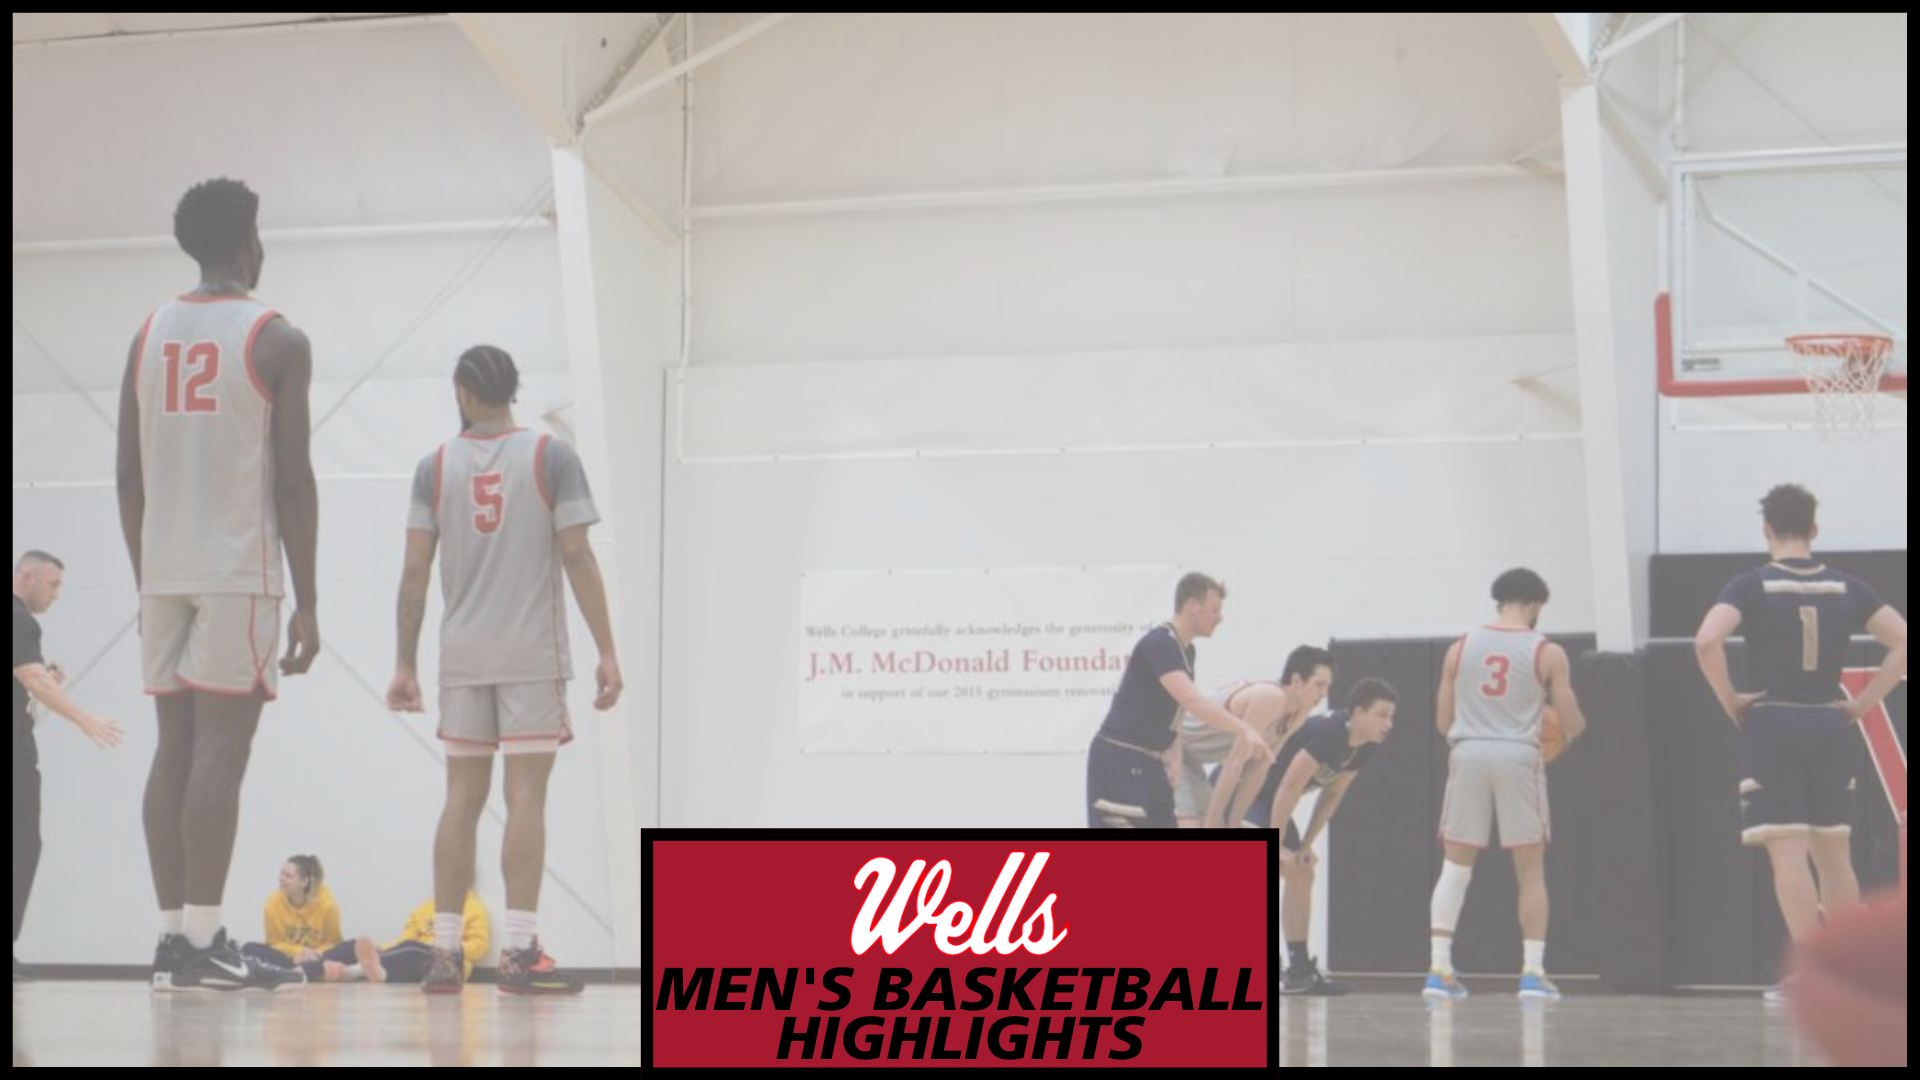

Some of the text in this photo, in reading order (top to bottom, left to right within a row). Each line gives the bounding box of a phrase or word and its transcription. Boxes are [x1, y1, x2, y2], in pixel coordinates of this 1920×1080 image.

[162, 341, 220, 415] 12
[471, 472, 505, 535] 5
[805, 624, 837, 638] Wells
[841, 624, 886, 640] College
[891, 623, 949, 639] gratefully
[955, 621, 1040, 637] acknowledges
[1045, 621, 1064, 634] the
[1069, 621, 1134, 636] generosity
[1799, 606, 1818, 671] 1
[805, 650, 862, 682] J.M.
[871, 648, 1010, 674] McDonald
[1482, 654, 1511, 698] 3
[841, 686, 854, 698] in
[858, 687, 906, 702] support
[910, 686, 924, 699] of
[927, 687, 949, 699] our
[953, 685, 982, 699] 2015
[986, 687, 1061, 701] gymnasium
